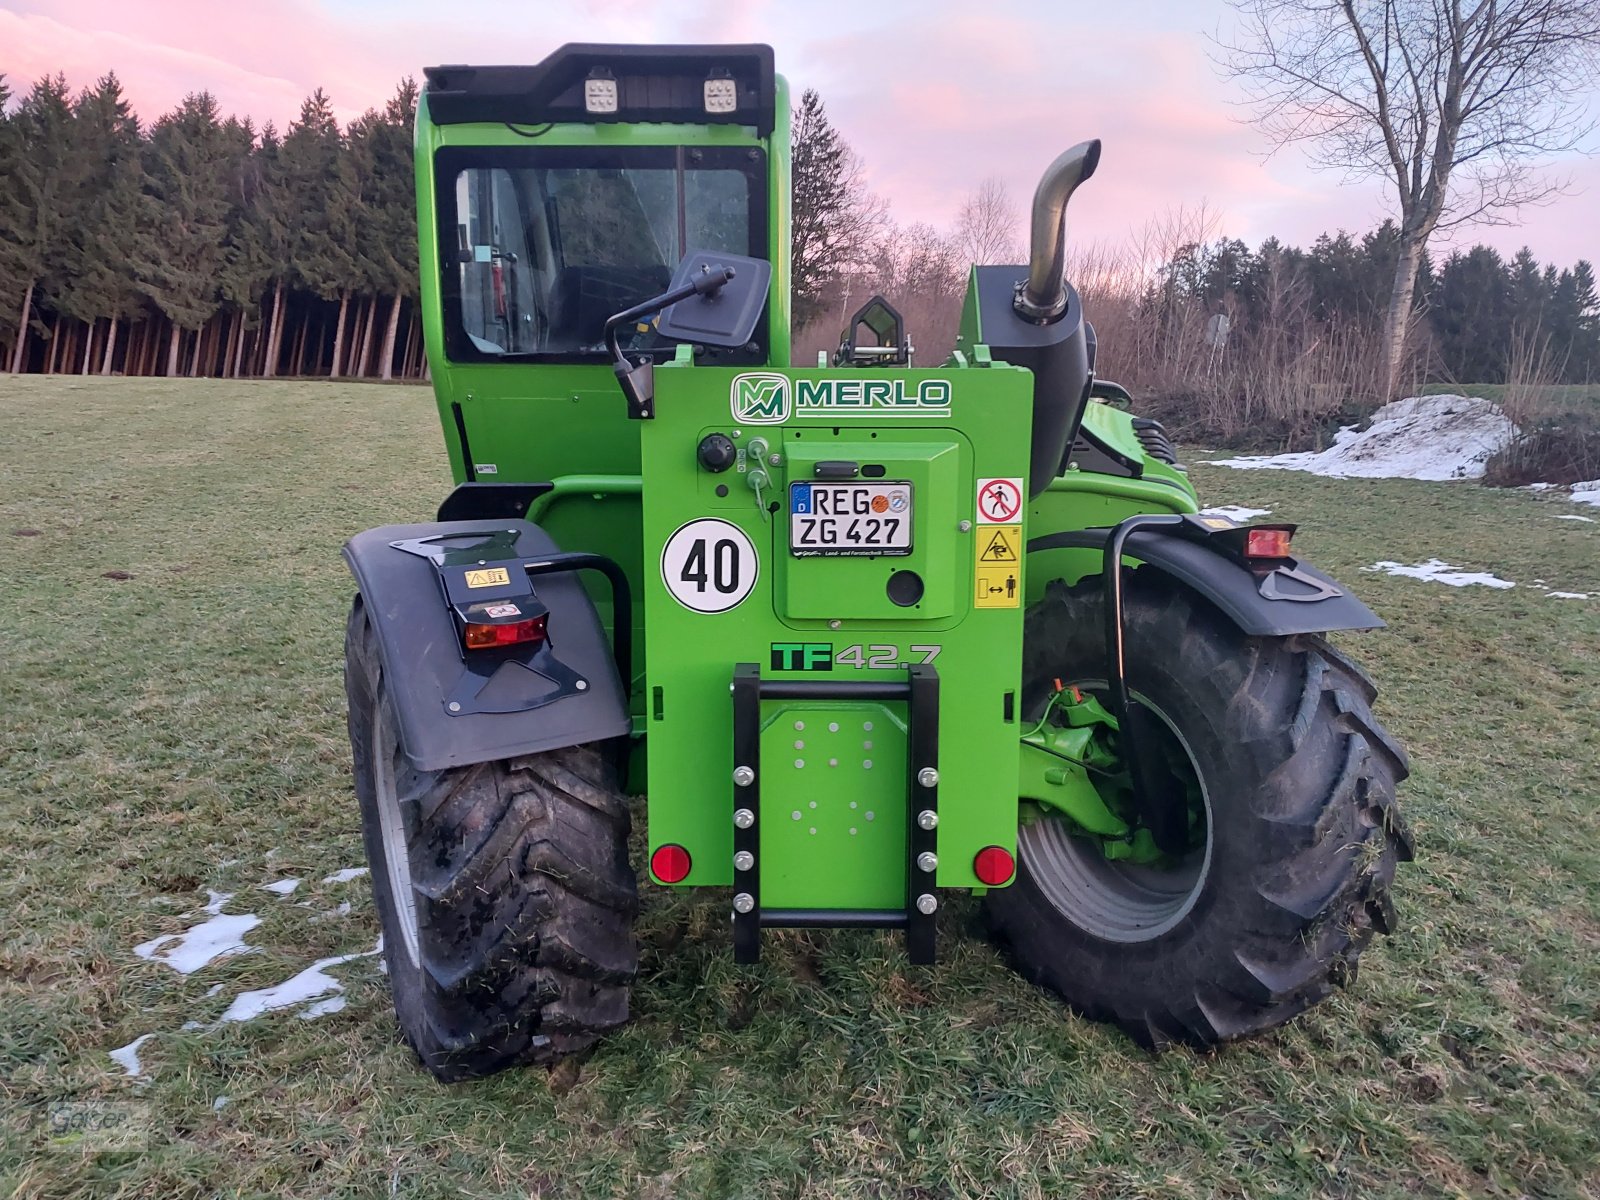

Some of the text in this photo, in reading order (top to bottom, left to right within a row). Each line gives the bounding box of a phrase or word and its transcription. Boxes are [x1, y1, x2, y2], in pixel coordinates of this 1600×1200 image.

[796, 380, 952, 407] MERLO
[797, 489, 870, 515] D REG
[800, 519, 900, 544] ZG 427
[681, 538, 740, 594] 40
